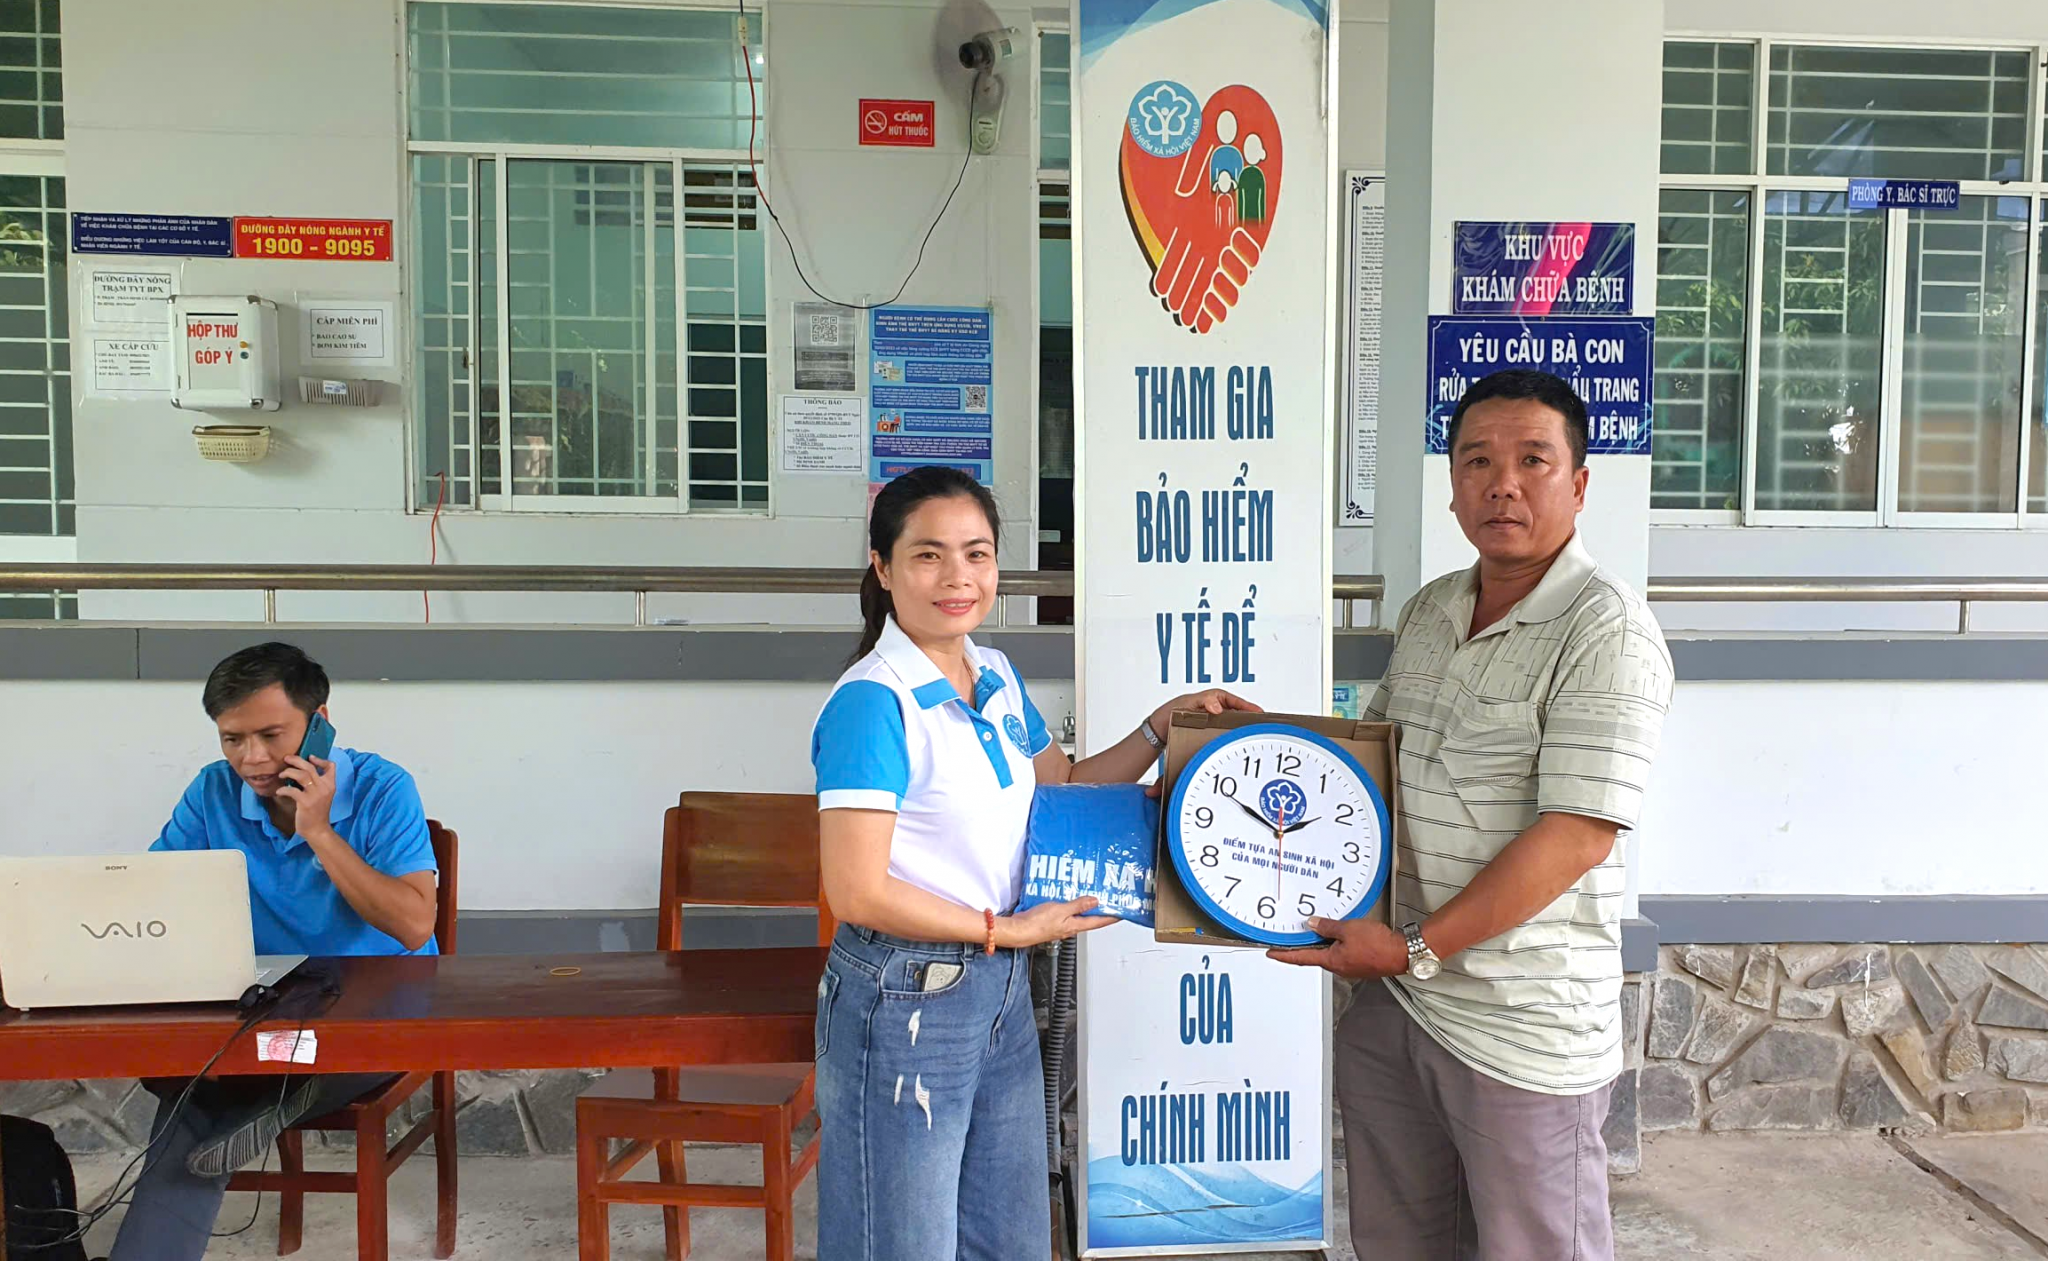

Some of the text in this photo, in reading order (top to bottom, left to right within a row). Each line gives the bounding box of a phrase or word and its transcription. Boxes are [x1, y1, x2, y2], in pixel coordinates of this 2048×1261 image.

[894, 110, 924, 122] CẤM
[1190, 118, 1200, 136] NAM
[888, 124, 928, 136] HÚT THUỐC
[1852, 182, 1882, 202] PHÒNG
[1886, 187, 1894, 204] Y,
[1897, 184, 1916, 202] BÁC
[1930, 186, 1956, 206] TRỰC
[241, 224, 384, 236] ĐƯỜNG DÂY NÓNG NGÀNH Y TẾ
[252, 238, 303, 254] 1900
[325, 239, 375, 256] 9095
[1504, 230, 1584, 266] KHU VỰC
[128, 285, 146, 293] TYT
[1462, 269, 1624, 308] KHÁM CHỮA BỆNH
[187, 320, 238, 340] HỘP THƯ
[195, 346, 233, 364] GÓP Ý
[1459, 328, 1624, 364] YÊU CẦU BÀ CON
[1439, 368, 1467, 401] RỬA
[1594, 378, 1639, 402] TRANG
[1135, 366, 1274, 440] THAM GIA
[1600, 410, 1638, 445] BỆNH
[1136, 462, 1273, 563] BẢO HIỂM
[1156, 584, 1257, 684] Y TẾ ĐỂ
[1244, 756, 1261, 778] 11
[1276, 753, 1301, 778] 12
[1213, 774, 1237, 797] 10
[1320, 774, 1326, 794] 1
[1195, 807, 1214, 829] 9
[1334, 804, 1354, 826] 2
[1200, 845, 1219, 867] 8
[1223, 837, 1335, 870] ĐIỂM TỰA AN SINH XÃ HỘI
[1232, 851, 1319, 878] CỦA MỌI NGƯỜI DÂN
[1342, 842, 1360, 864] 3
[1029, 850, 1096, 885] HIỂM
[1224, 876, 1242, 898] 7
[1326, 877, 1345, 898] 4
[1257, 896, 1276, 919] 6
[1297, 894, 1316, 917] 5
[81, 920, 167, 939] VAIO
[1180, 955, 1233, 1045] CỦA
[1121, 1078, 1290, 1166] CHÍNH MÌNH
